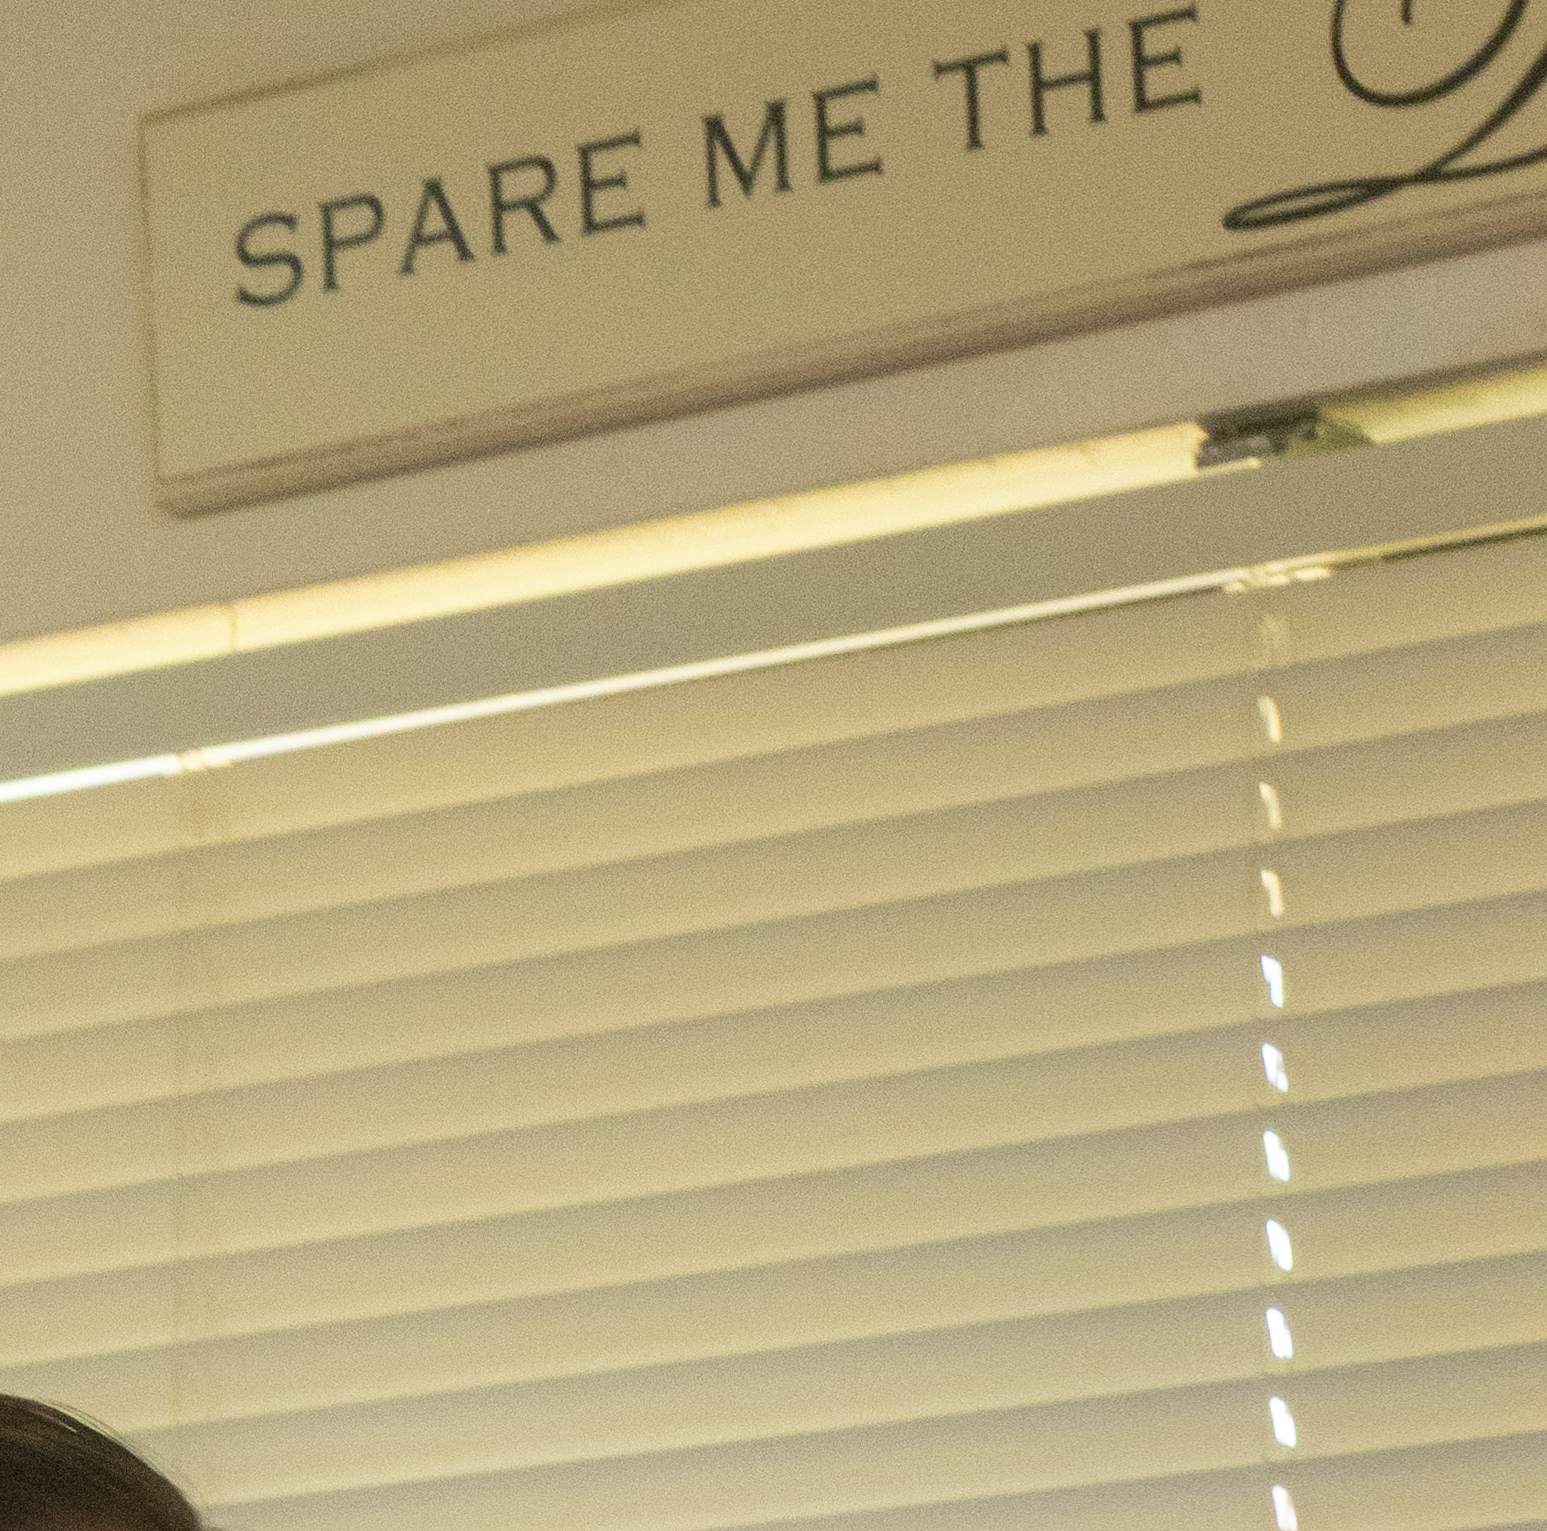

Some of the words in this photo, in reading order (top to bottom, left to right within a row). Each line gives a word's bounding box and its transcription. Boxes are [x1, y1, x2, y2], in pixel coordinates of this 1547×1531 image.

[235, 127, 646, 308] SPARE
[702, 73, 884, 209] ME
[932, 2, 1203, 151] THE
